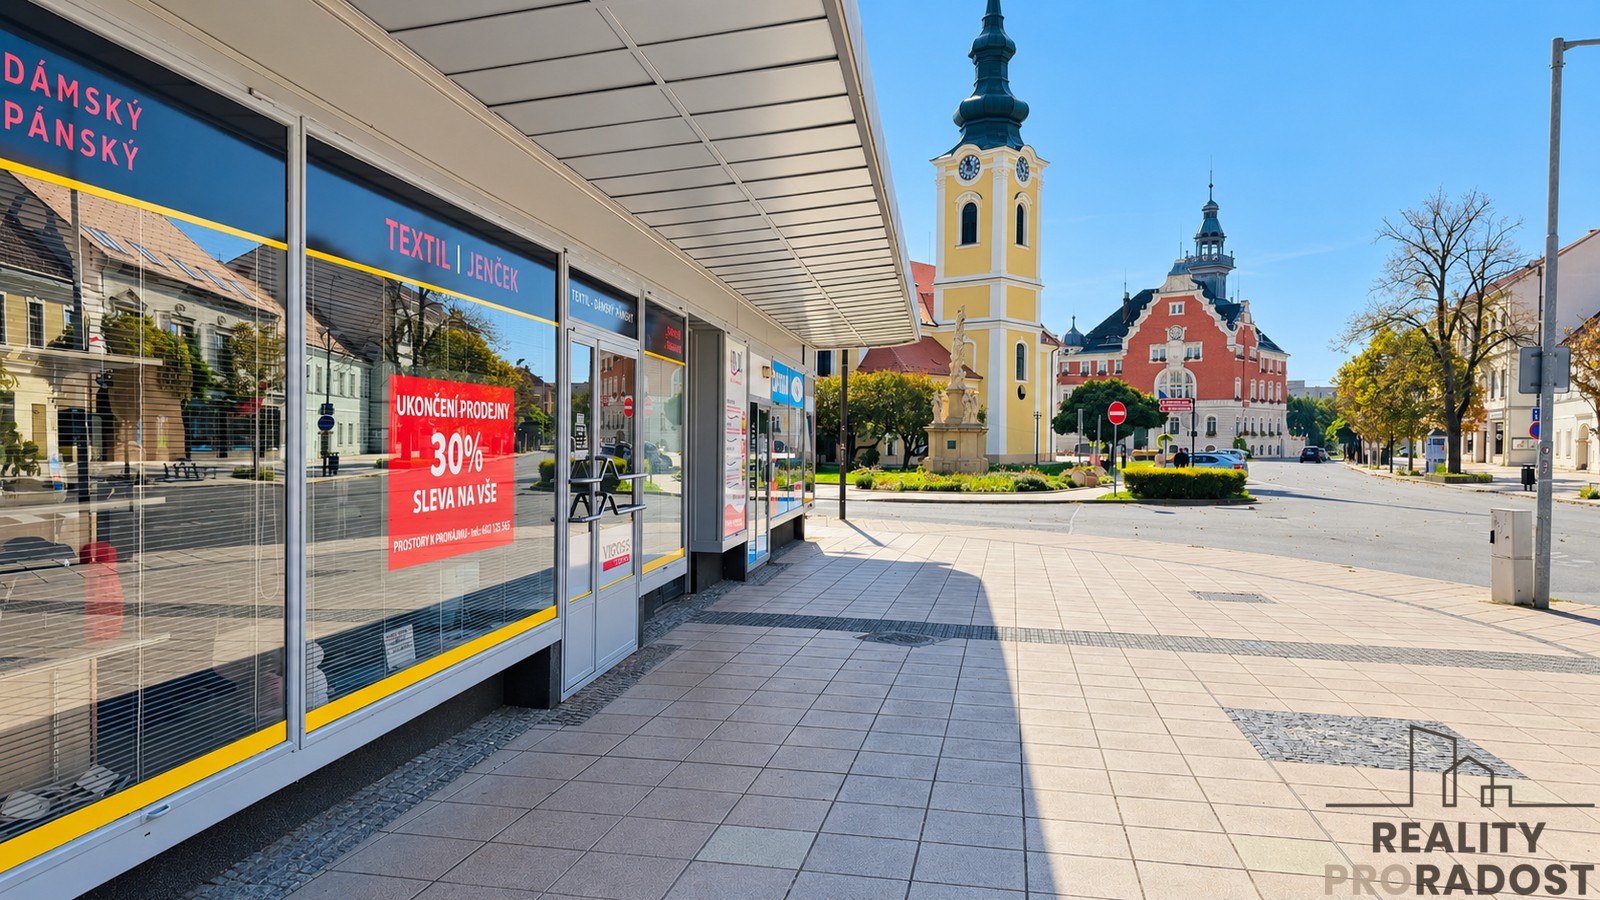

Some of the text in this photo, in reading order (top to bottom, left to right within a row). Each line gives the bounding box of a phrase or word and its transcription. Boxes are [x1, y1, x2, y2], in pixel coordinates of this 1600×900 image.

[4, 51, 142, 131] DÁMSKÝ
[4, 100, 139, 171] PÁNSKÝ
[385, 217, 519, 294] TEXTIL JENČEK
[396, 392, 511, 420] UKONČENÍ PRODEJNY
[430, 431, 483, 477] 30%
[412, 478, 497, 514] SLEVA NA VŠE
[393, 534, 429, 553] PROSTORY
[430, 534, 435, 546] K
